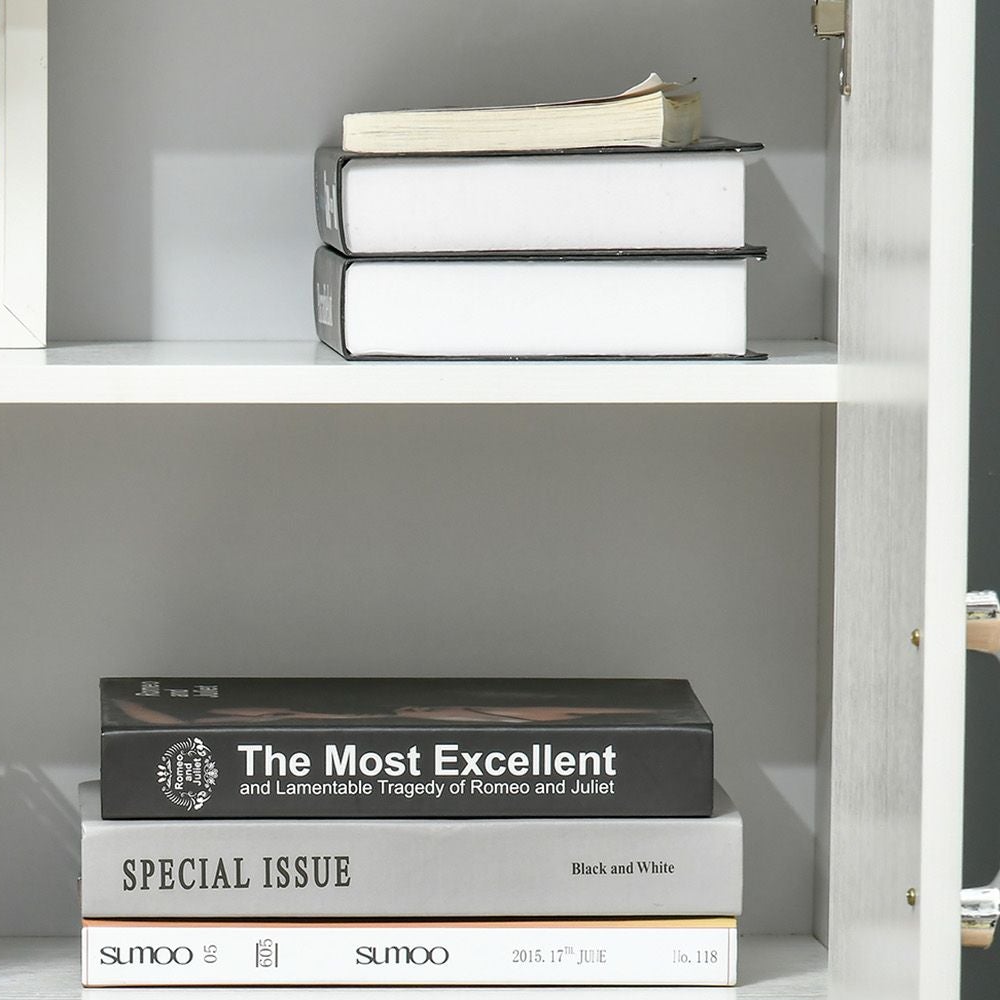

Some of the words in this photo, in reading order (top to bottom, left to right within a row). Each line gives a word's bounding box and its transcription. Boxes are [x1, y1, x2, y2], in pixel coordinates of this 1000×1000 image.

[237, 744, 311, 777] The
[325, 744, 421, 777] Most
[434, 744, 617, 776] Excellent
[174, 754, 184, 790] Romeo
[183, 762, 192, 782] and
[192, 757, 202, 786] Juliet
[240, 780, 271, 795] and
[276, 780, 373, 795] Lamentable
[377, 780, 445, 798] Tragedy
[449, 779, 466, 795] of
[470, 779, 530, 794] Romeo
[535, 779, 566, 794] and
[571, 779, 615, 794] Juliet
[122, 857, 251, 891] SPECIAL
[262, 856, 351, 888] ISSUE
[571, 861, 607, 875] Black
[610, 861, 634, 874] and
[636, 860, 675, 874] White
[203, 944, 218, 964] 05
[511, 949, 546, 964] 2015.
[696, 950, 718, 964] 118
